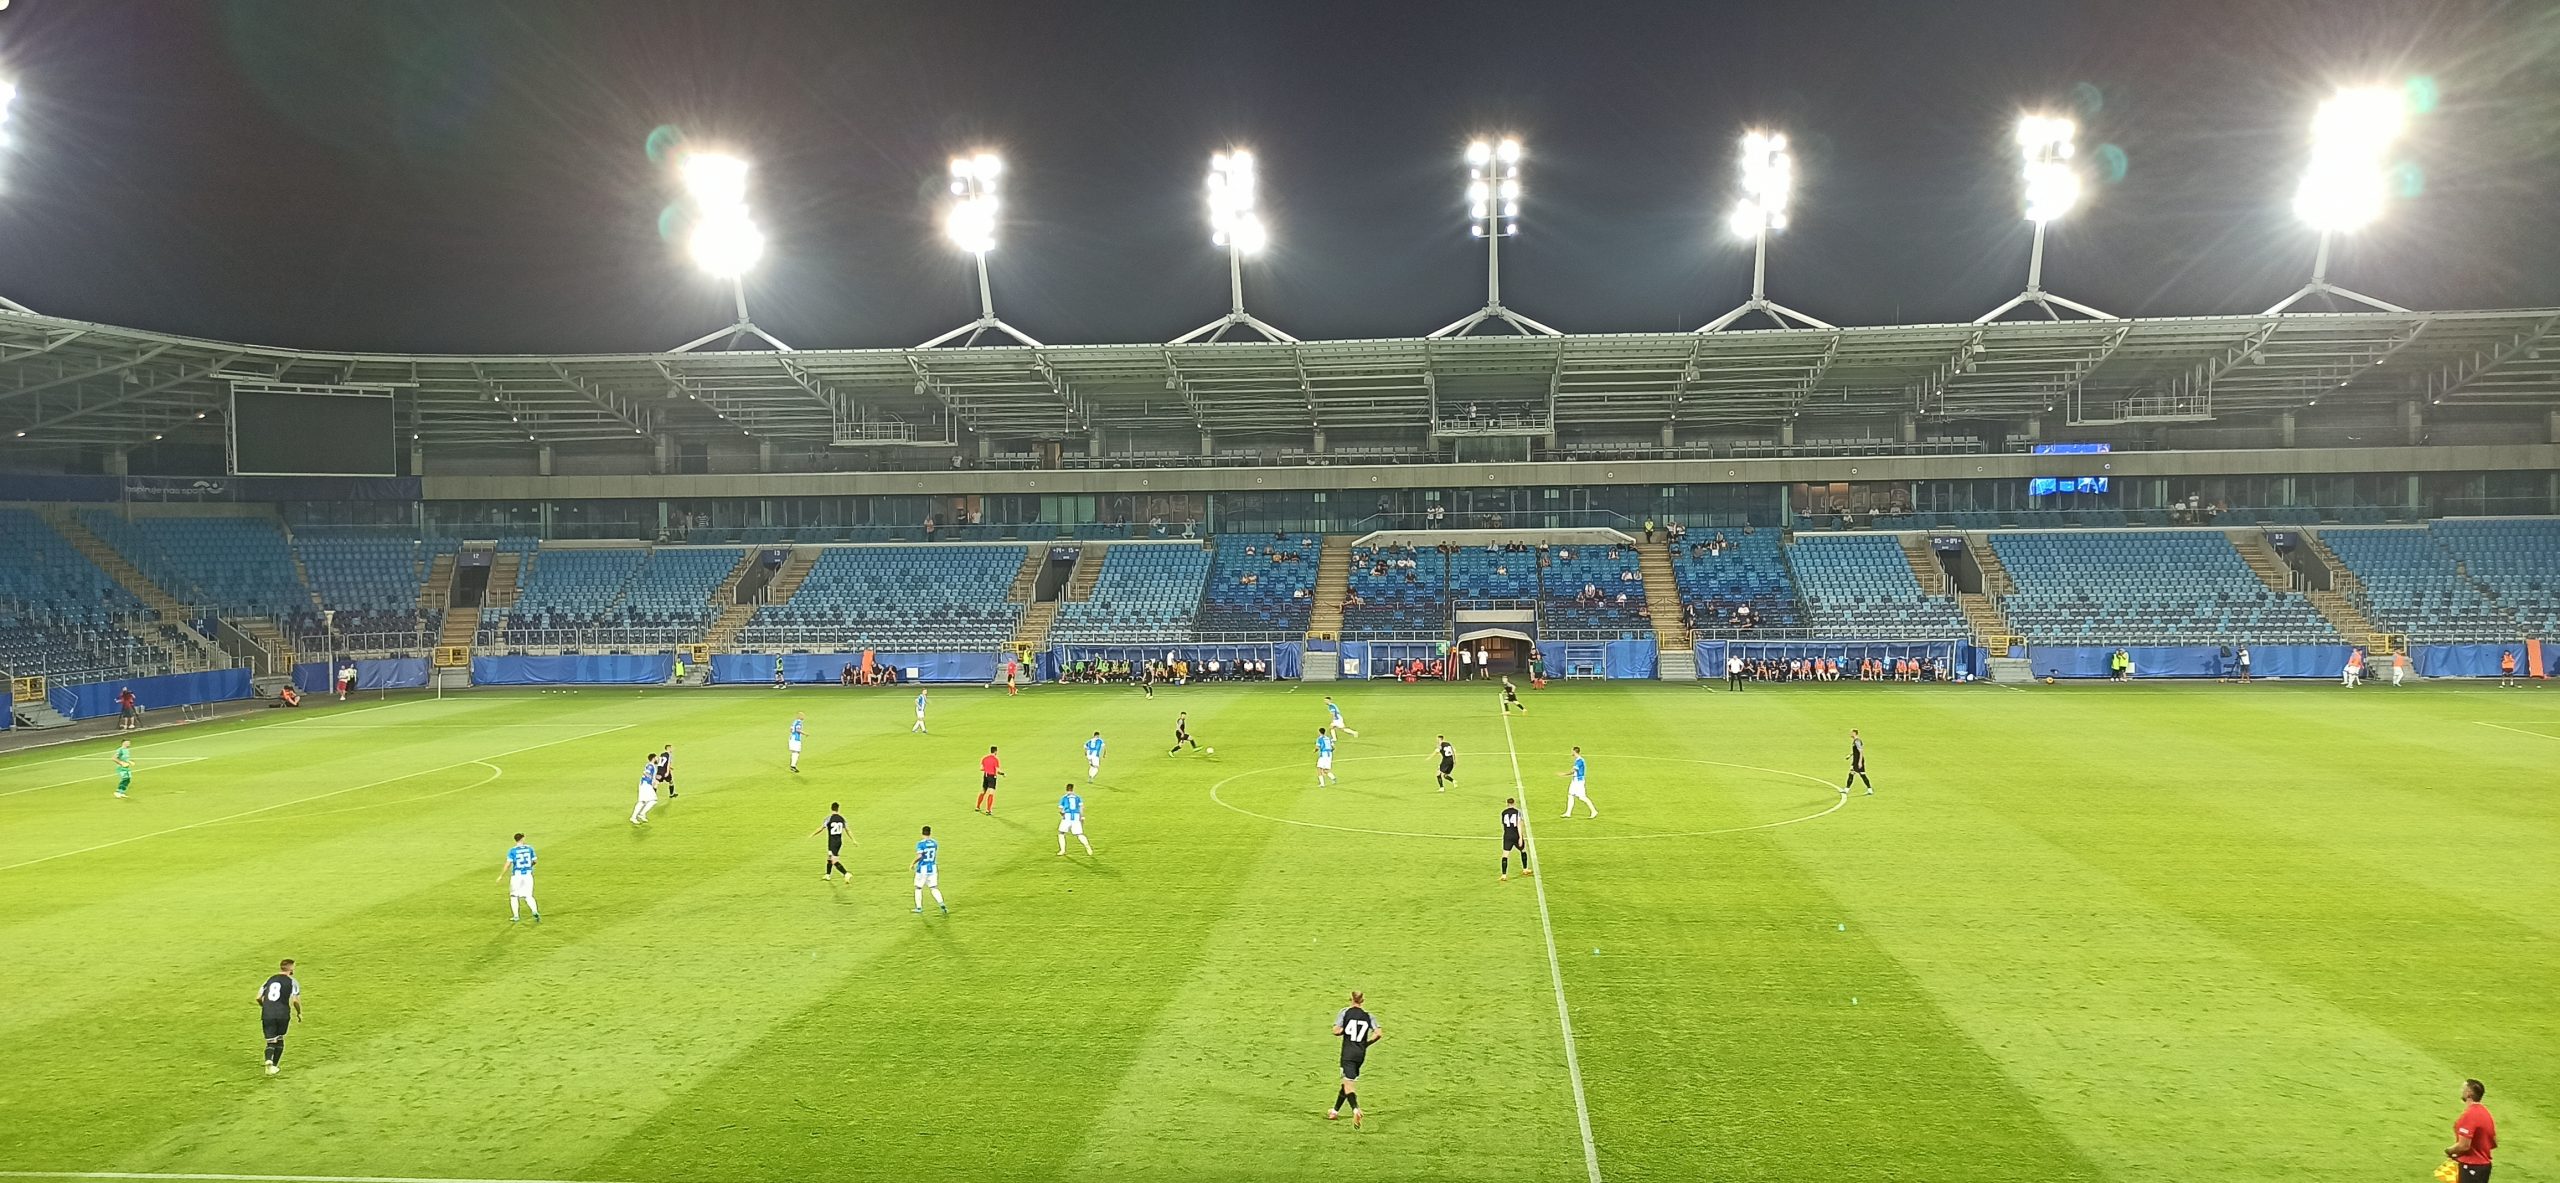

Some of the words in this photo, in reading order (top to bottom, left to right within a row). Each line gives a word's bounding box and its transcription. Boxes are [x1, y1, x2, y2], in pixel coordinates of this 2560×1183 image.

[1503, 813, 1518, 828] 44
[830, 822, 843, 835] 20
[516, 853, 532, 868] 23
[268, 982, 281, 1002] 8
[1345, 1019, 1369, 1043] 47
